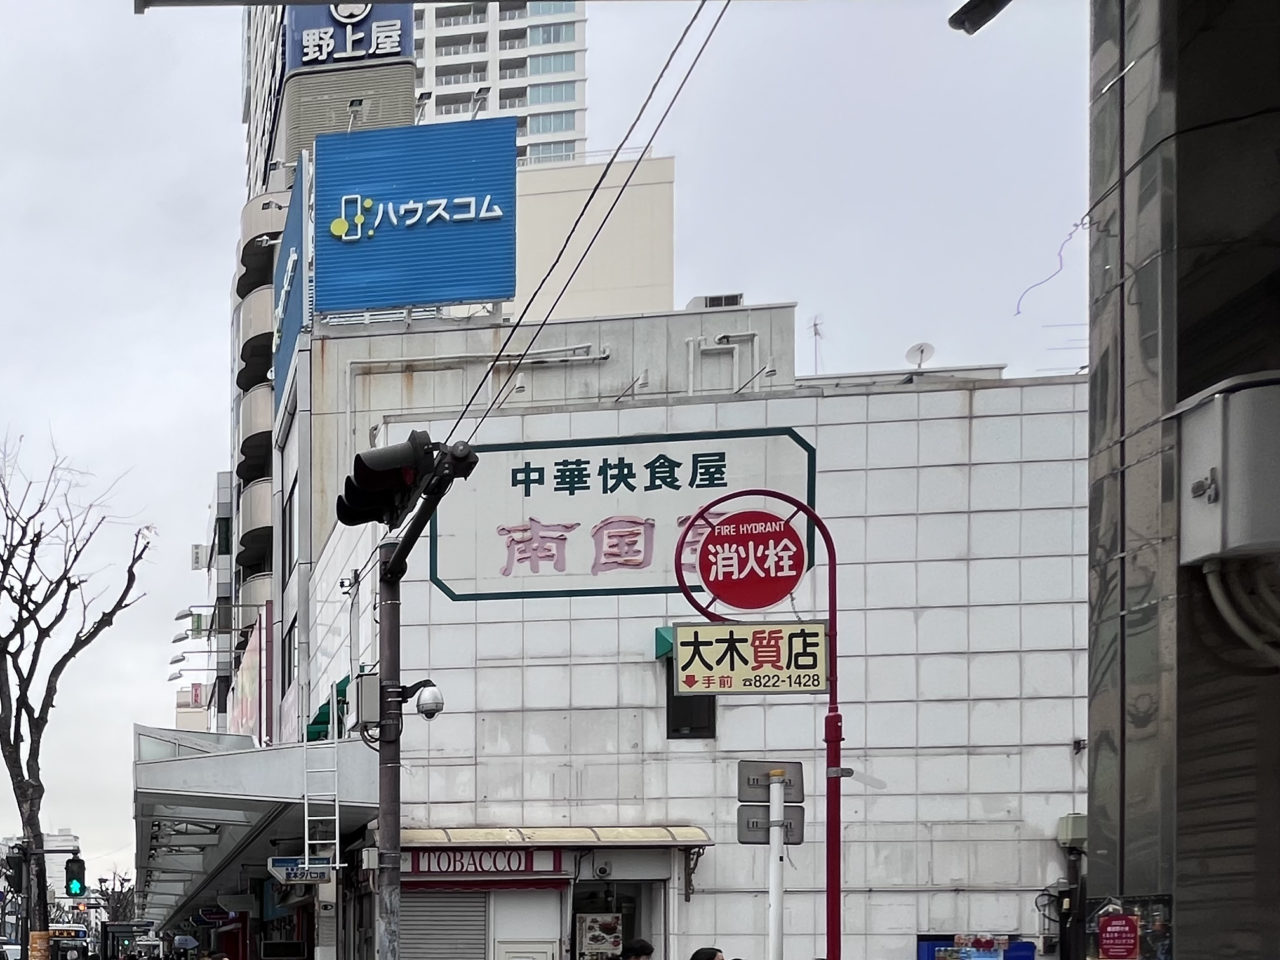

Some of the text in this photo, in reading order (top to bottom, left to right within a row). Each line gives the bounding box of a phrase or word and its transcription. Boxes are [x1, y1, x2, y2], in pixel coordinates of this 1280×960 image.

[302, 20, 402, 62] 野上屋
[374, 195, 503, 229] ハウスコム
[511, 451, 728, 497] 中華快食屋
[714, 521, 785, 536] FIRE HYDRANT
[707, 538, 797, 581] 消火栓
[679, 629, 820, 672] 大木質店
[702, 675, 733, 688] 手前
[753, 674, 820, 688] 822-1428
[422, 851, 523, 872] TOBACCO
